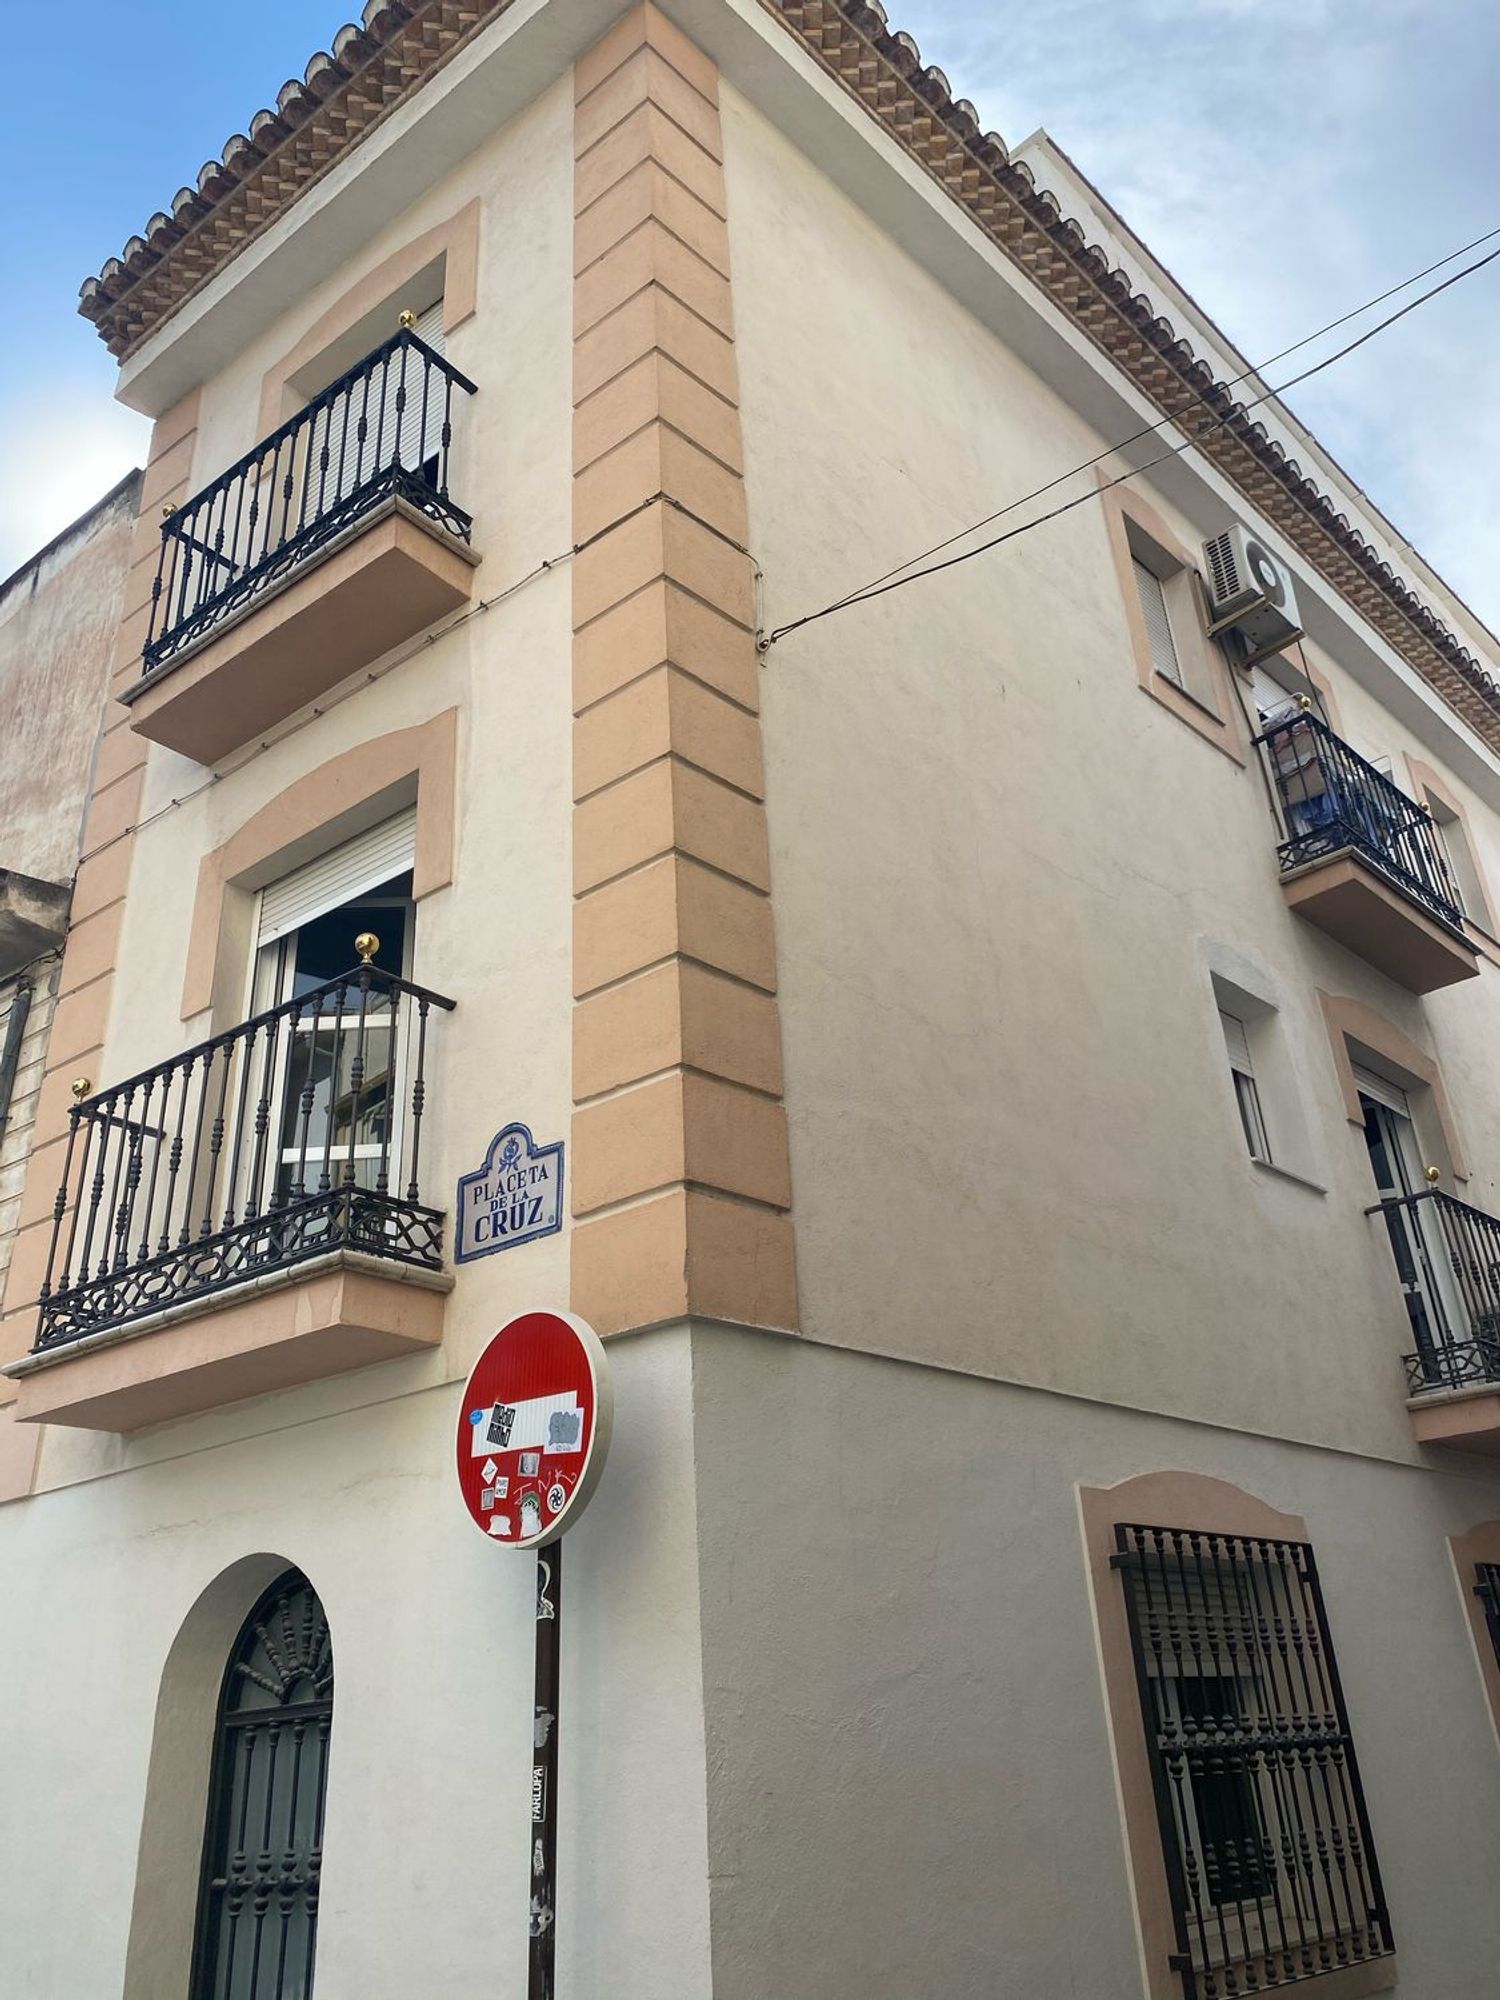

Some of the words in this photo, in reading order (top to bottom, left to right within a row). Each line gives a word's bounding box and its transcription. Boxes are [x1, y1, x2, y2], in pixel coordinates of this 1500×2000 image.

[473, 1164, 549, 1205] PLACETA
[490, 1197, 508, 1211] DE
[512, 1191, 529, 1204] LA
[474, 1196, 544, 1242] CRUZ
